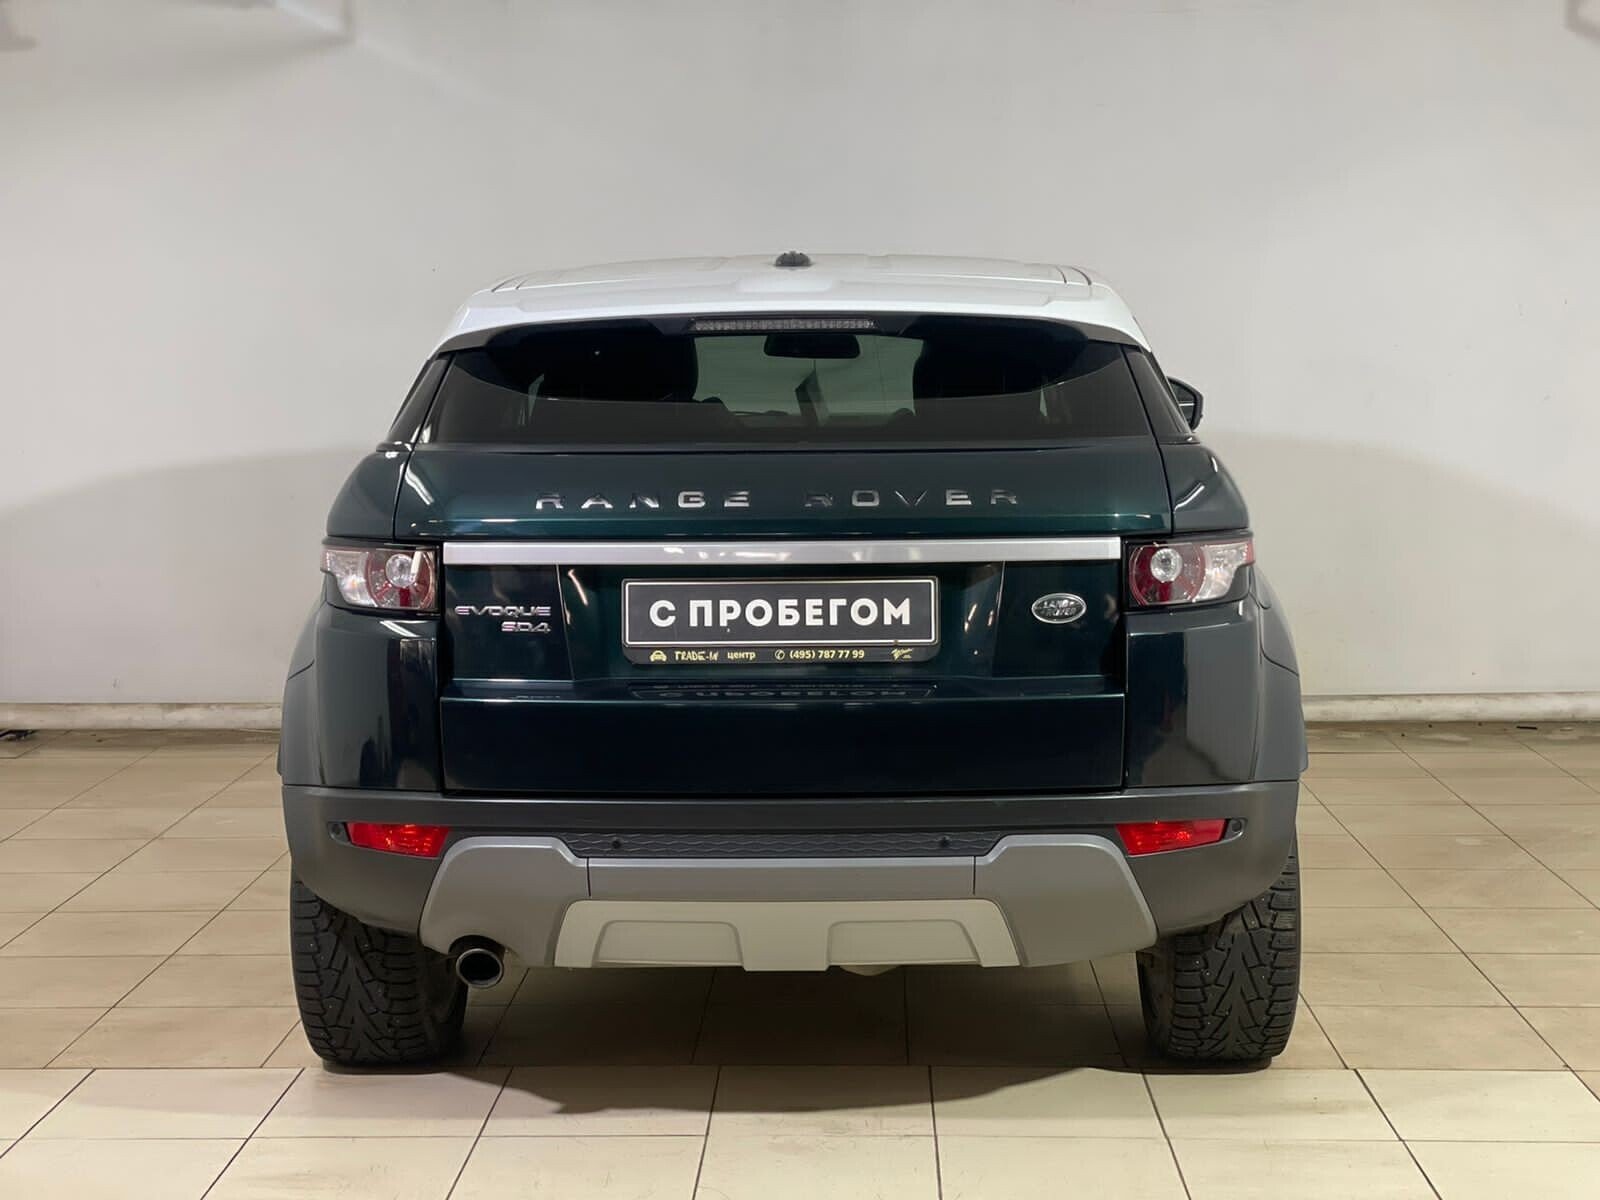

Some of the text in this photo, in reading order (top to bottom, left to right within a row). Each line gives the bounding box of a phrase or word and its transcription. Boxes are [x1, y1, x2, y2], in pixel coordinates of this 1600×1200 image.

[535, 489, 1018, 510] RANGE ROVER
[454, 605, 552, 618] EVOQUE
[649, 597, 911, 628] С ПРОБЕГОМ
[501, 621, 551, 633] SD4
[727, 651, 757, 661] центр
[789, 649, 816, 660] (495)
[818, 649, 836, 660] 787
[838, 649, 850, 660] 77
[852, 649, 866, 660] 99
